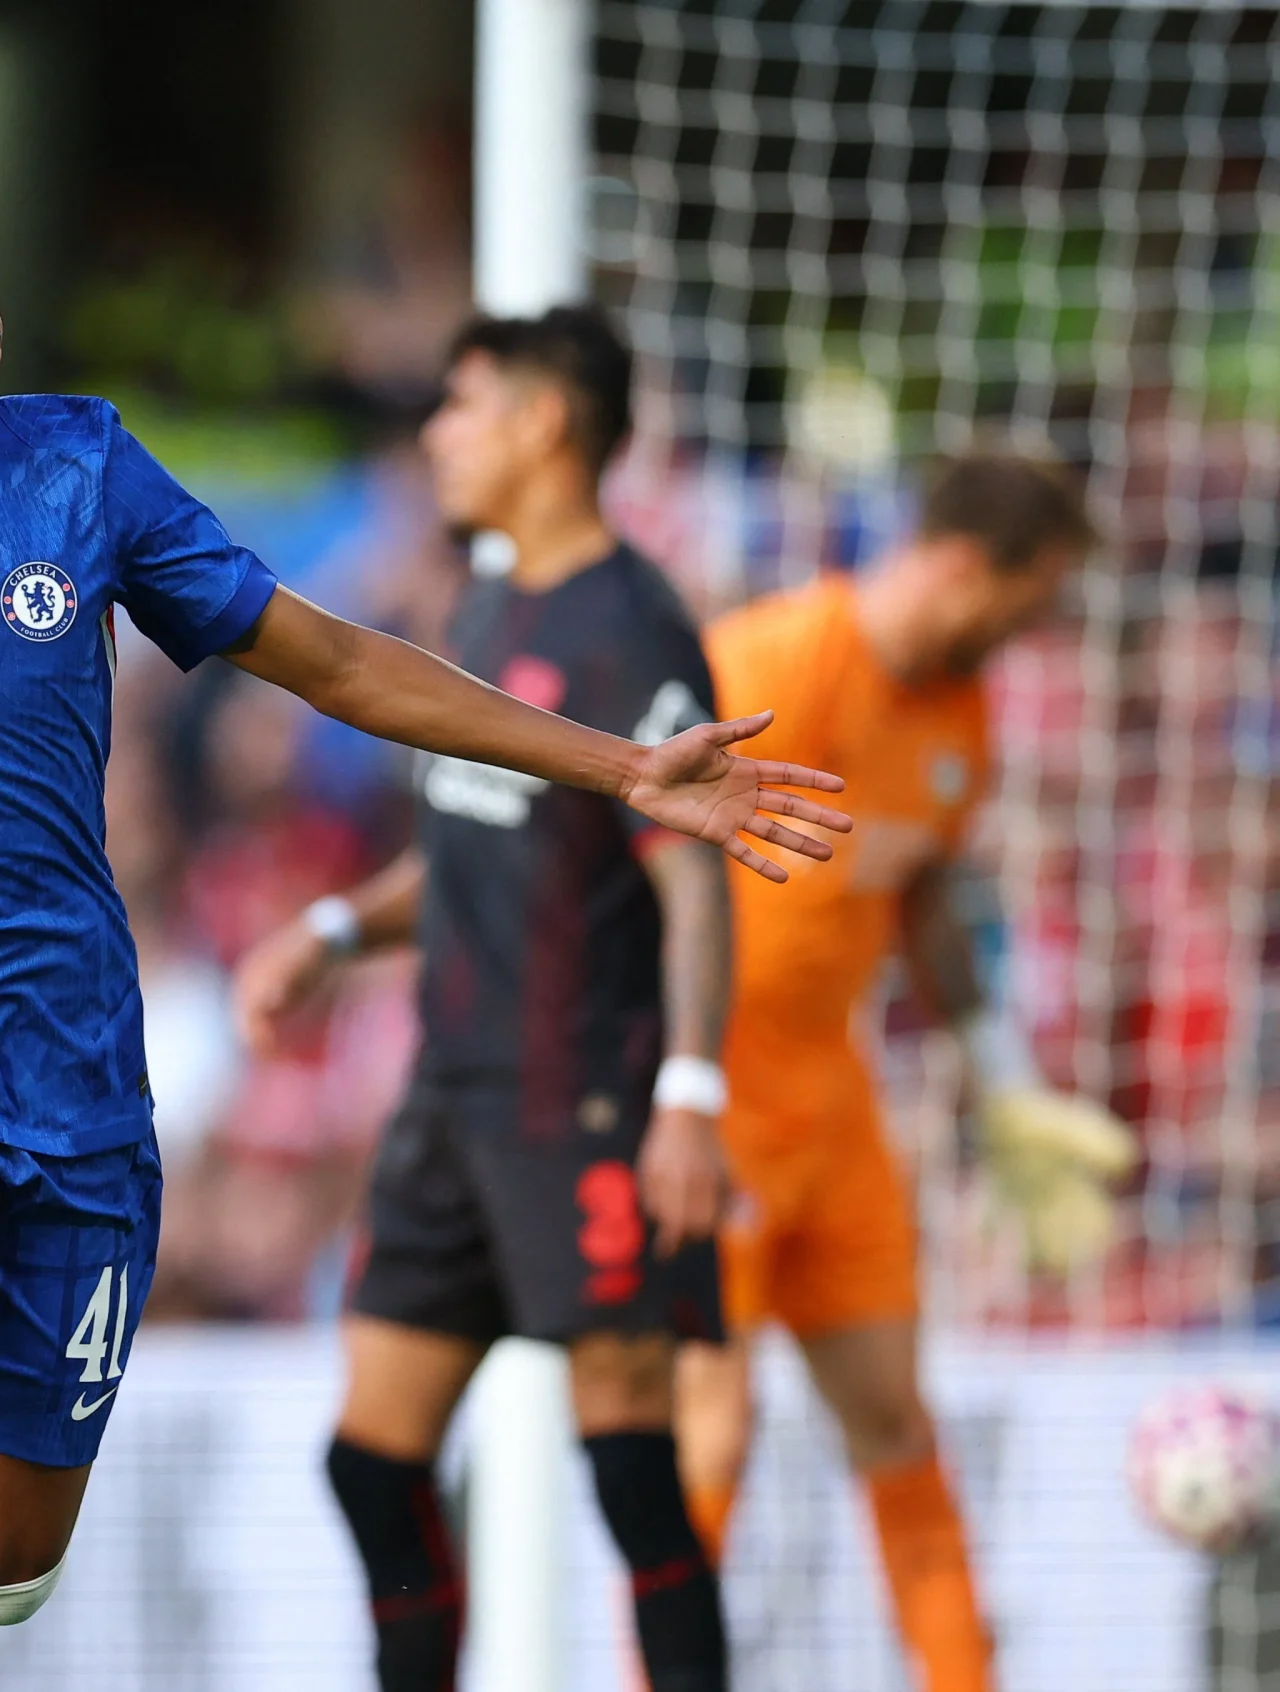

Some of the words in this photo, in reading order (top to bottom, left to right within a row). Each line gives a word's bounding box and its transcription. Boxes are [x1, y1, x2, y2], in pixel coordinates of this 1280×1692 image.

[9, 565, 56, 586] CHELSEA
[20, 627, 53, 638] FOOTBALL
[55, 617, 69, 632] CLUB
[65, 1261, 129, 1382] 41
